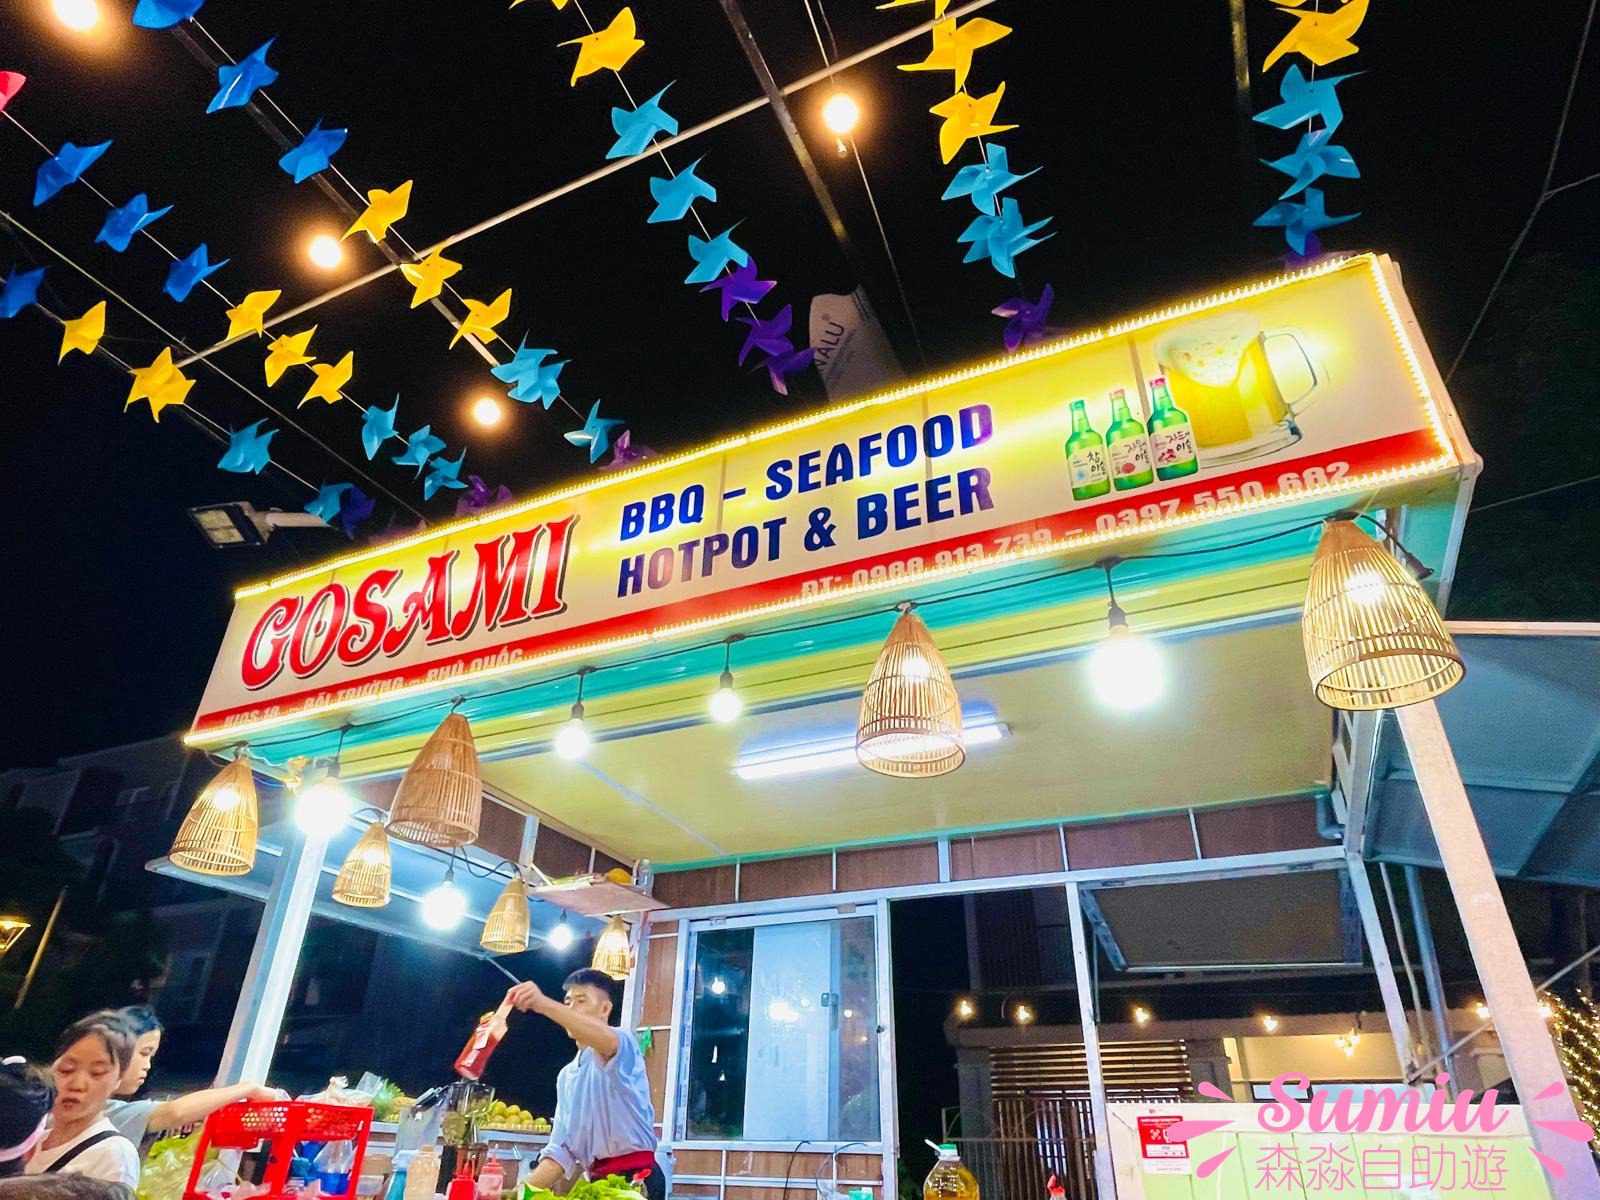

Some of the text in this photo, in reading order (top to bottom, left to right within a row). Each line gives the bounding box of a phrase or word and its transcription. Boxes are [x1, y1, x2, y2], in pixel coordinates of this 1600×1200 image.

[617, 467, 994, 598] HOTPOT & BEER
[620, 484, 705, 541] BBQ
[765, 404, 993, 501] SEAFOOD
[852, 557, 924, 586] 0988
[935, 543, 985, 568] 913
[994, 528, 1053, 554] 739
[1095, 498, 1181, 534] 0397
[1194, 481, 1265, 512] 550
[1278, 461, 1350, 493] 682
[241, 514, 581, 690] GOSAMI
